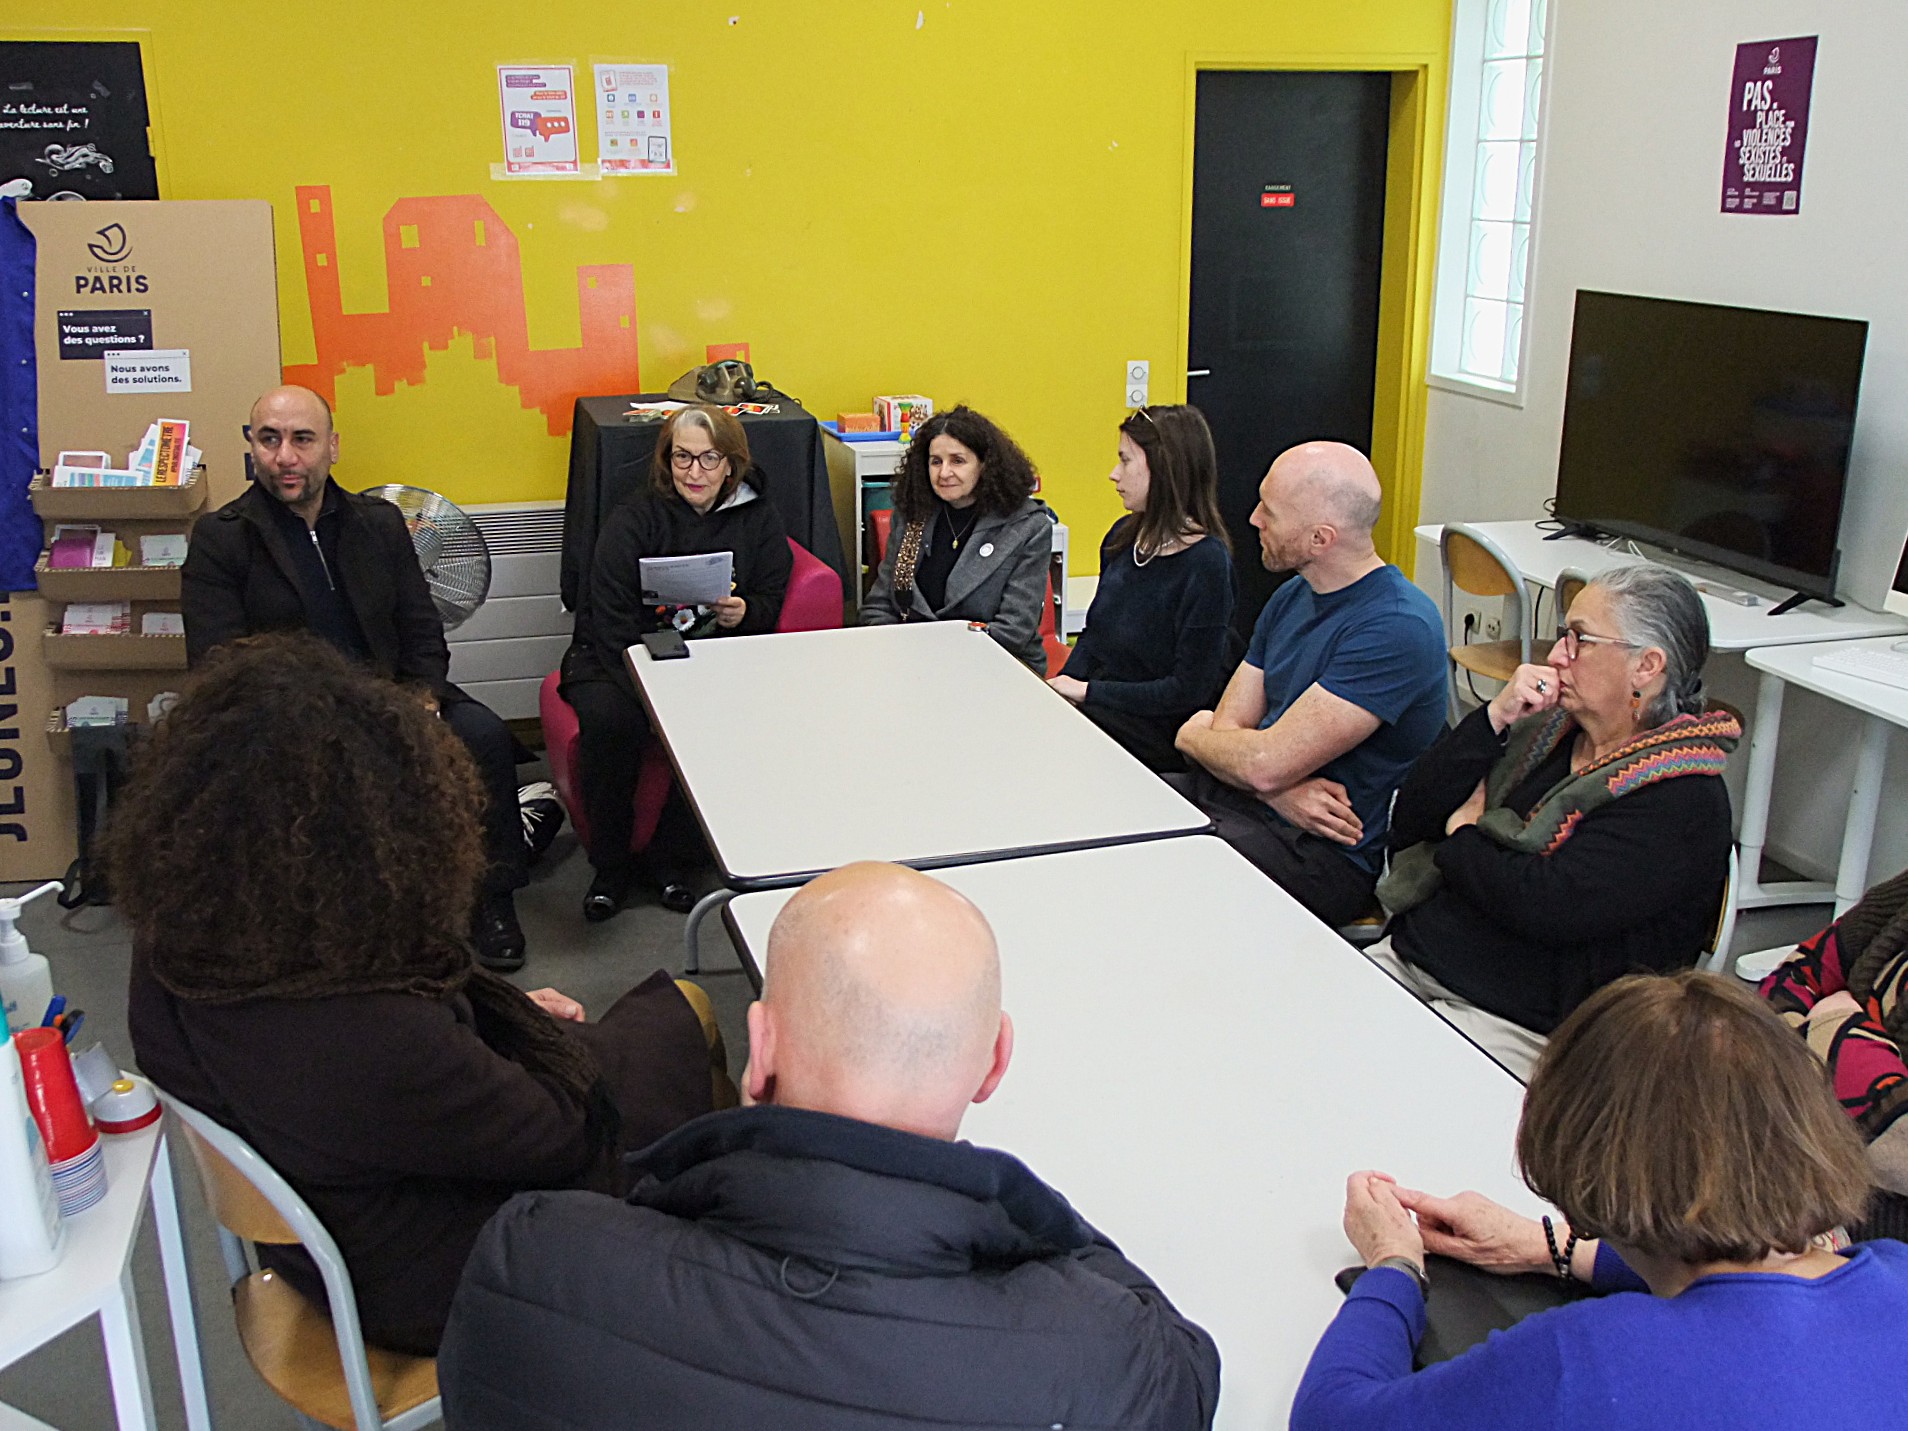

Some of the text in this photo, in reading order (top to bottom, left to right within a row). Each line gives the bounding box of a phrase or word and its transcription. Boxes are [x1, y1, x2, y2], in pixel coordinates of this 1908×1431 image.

[1743, 80, 1773, 112] PAS
[2, 103, 17, 114] La
[19, 103, 54, 114] lecture
[54, 103, 69, 114] est
[66, 119, 81, 132] fin
[84, 118, 90, 129] !
[1756, 110, 1786, 129] PLACE
[1742, 128, 1792, 147] VIOLENCES
[1738, 146, 1782, 165] SEXISTES
[1743, 163, 1795, 182] SEXUELLES
[87, 265, 137, 273] VILLE DE
[75, 274, 149, 295] PARIS
[62, 325, 90, 334] Vous
[63, 335, 145, 346] des questions ?
[110, 365, 170, 373] Nous avons
[111, 374, 182, 384] des solutions.
